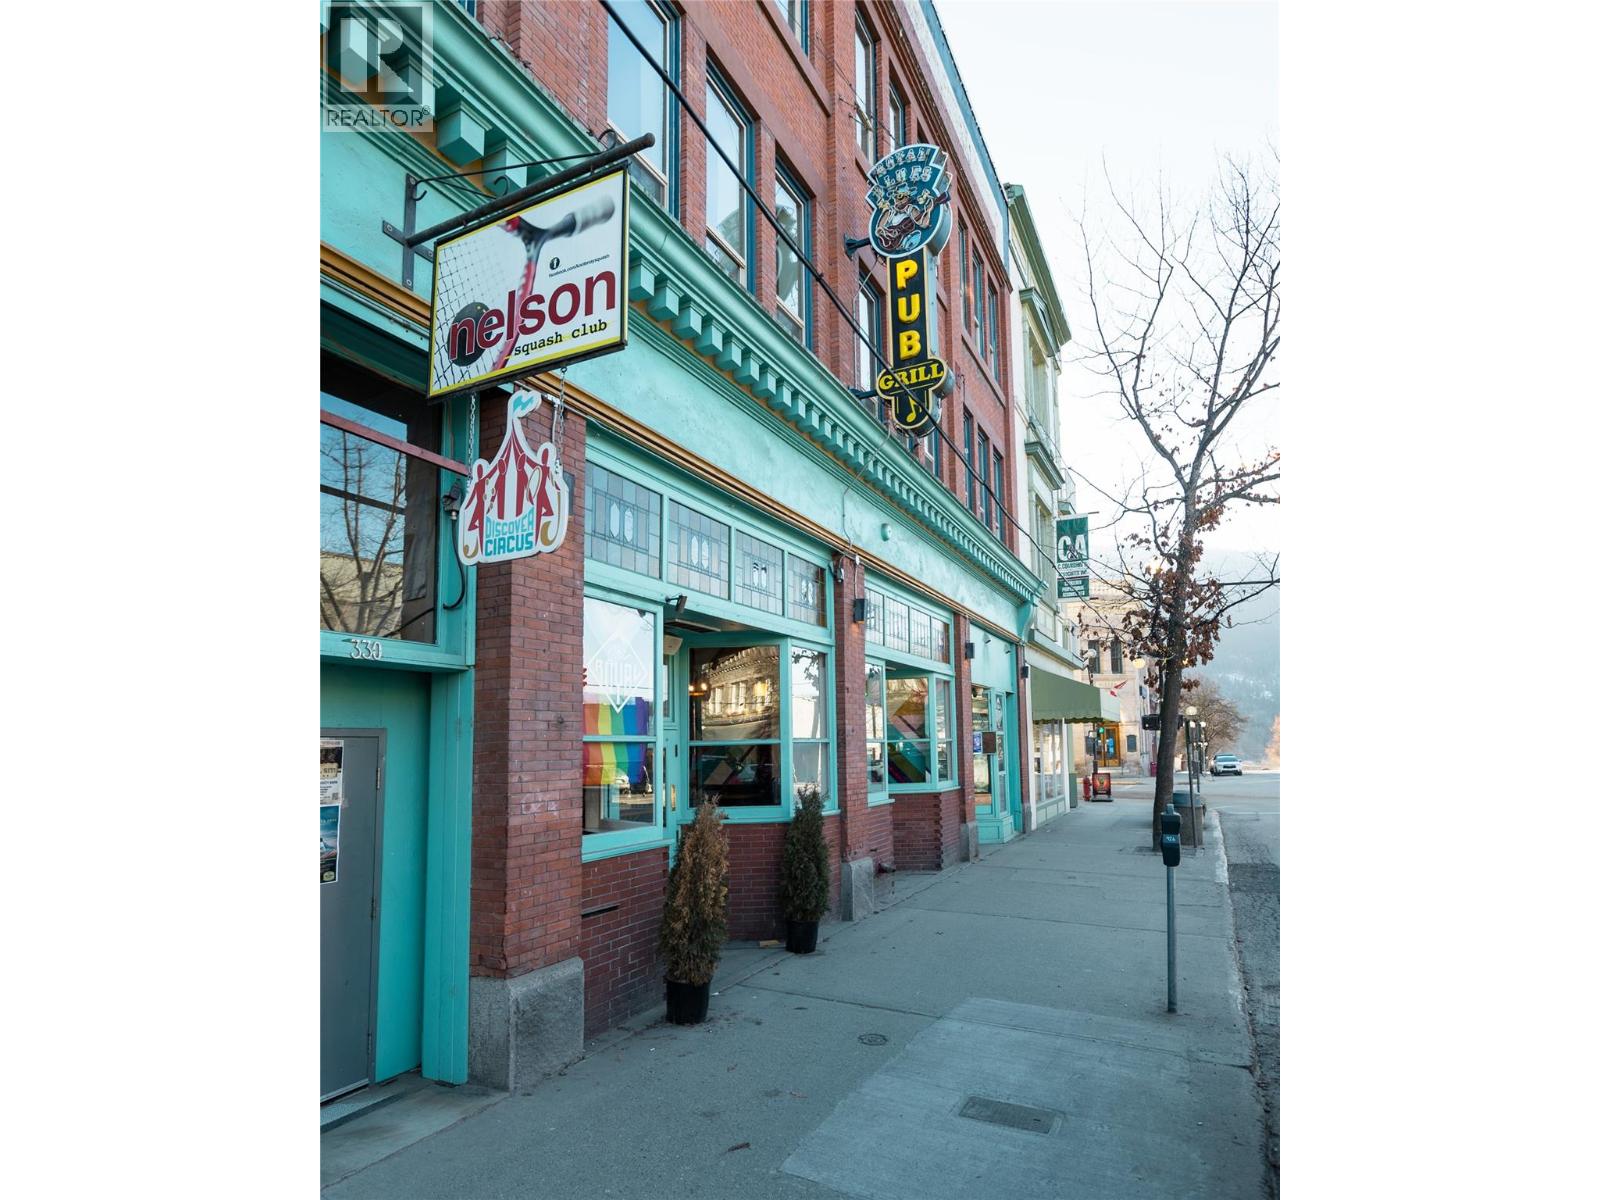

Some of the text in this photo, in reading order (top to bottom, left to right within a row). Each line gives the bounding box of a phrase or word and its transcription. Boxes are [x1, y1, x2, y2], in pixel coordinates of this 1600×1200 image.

[449, 270, 616, 361] nelson
[895, 259, 922, 361] PUB
[514, 319, 608, 356] squash club
[879, 363, 945, 391] GRILL
[485, 507, 535, 538] DISCOVER
[484, 533, 534, 556] CIRCUS
[351, 639, 382, 660] 330
